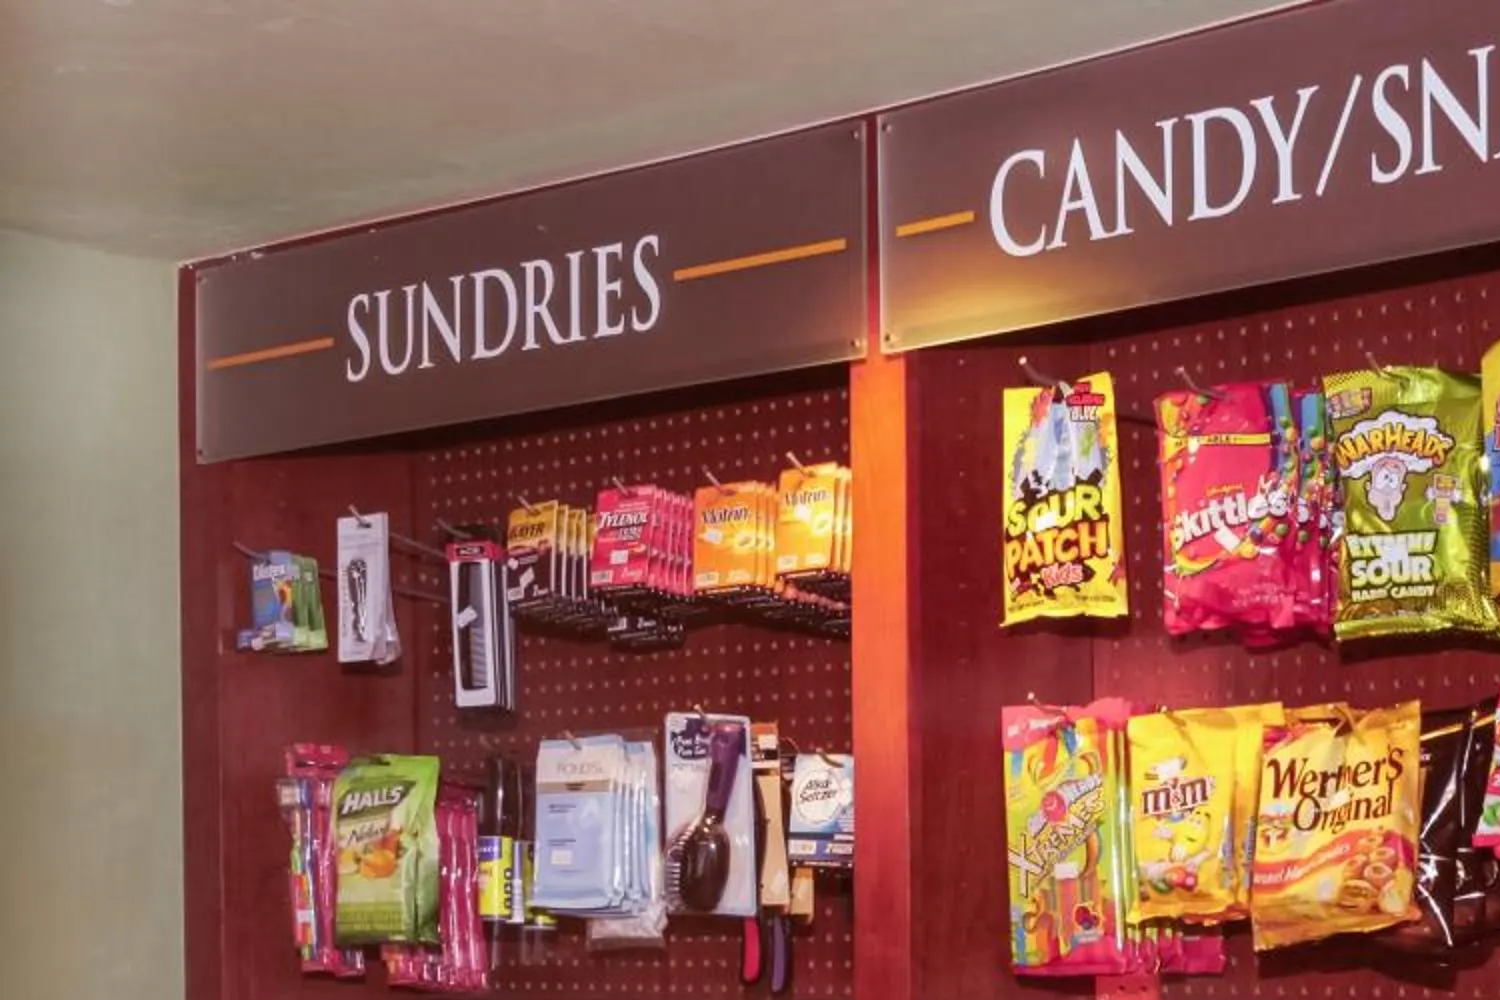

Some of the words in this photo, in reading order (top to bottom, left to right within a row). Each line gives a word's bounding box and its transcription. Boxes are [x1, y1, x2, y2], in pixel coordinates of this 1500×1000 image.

[346, 234, 662, 382] SUNDRIES
[1336, 421, 1453, 467] WARHEADS
[1006, 484, 1103, 537] SOUR
[1005, 519, 1110, 577] PATCH
[1350, 554, 1433, 588] SOUR
[341, 785, 404, 816] HALLS
